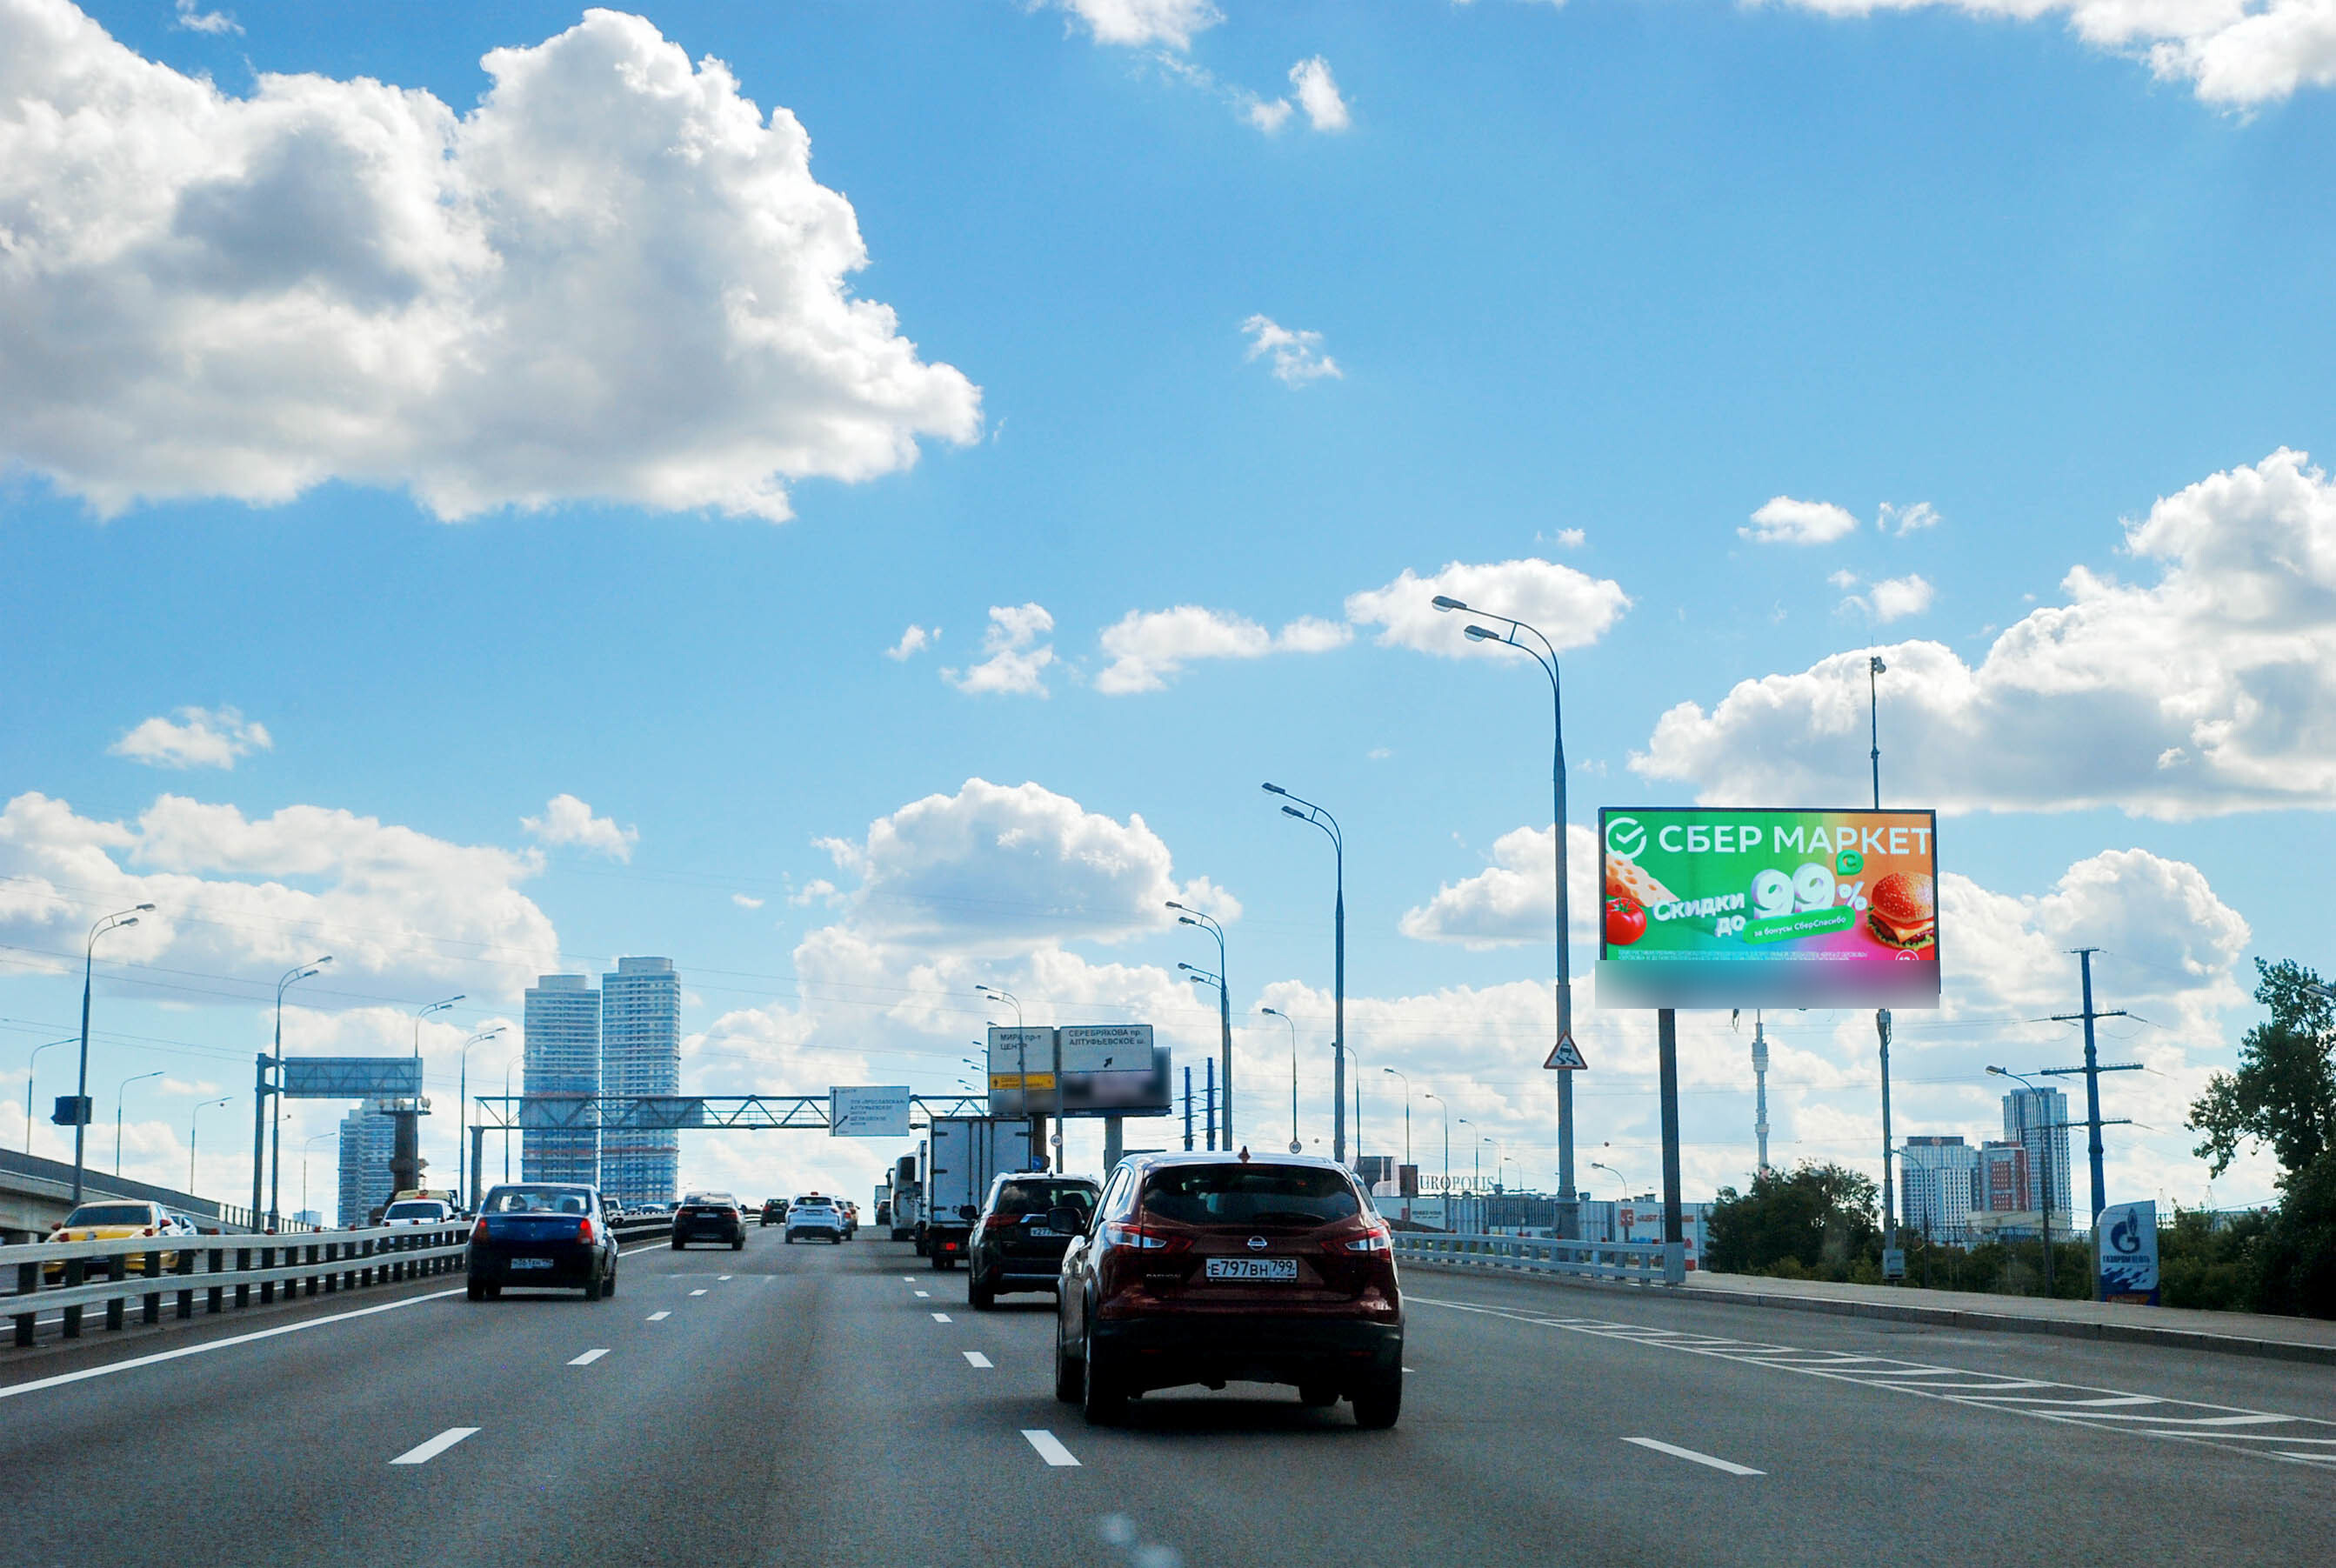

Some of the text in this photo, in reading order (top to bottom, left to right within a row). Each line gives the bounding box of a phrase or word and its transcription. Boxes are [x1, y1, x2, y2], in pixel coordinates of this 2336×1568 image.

[1659, 825, 1932, 855] СБЕР МАРКЕТ
[1714, 915, 1746, 937] до
[1069, 1029, 1129, 1038] СЕРЕБРЯКОВА
